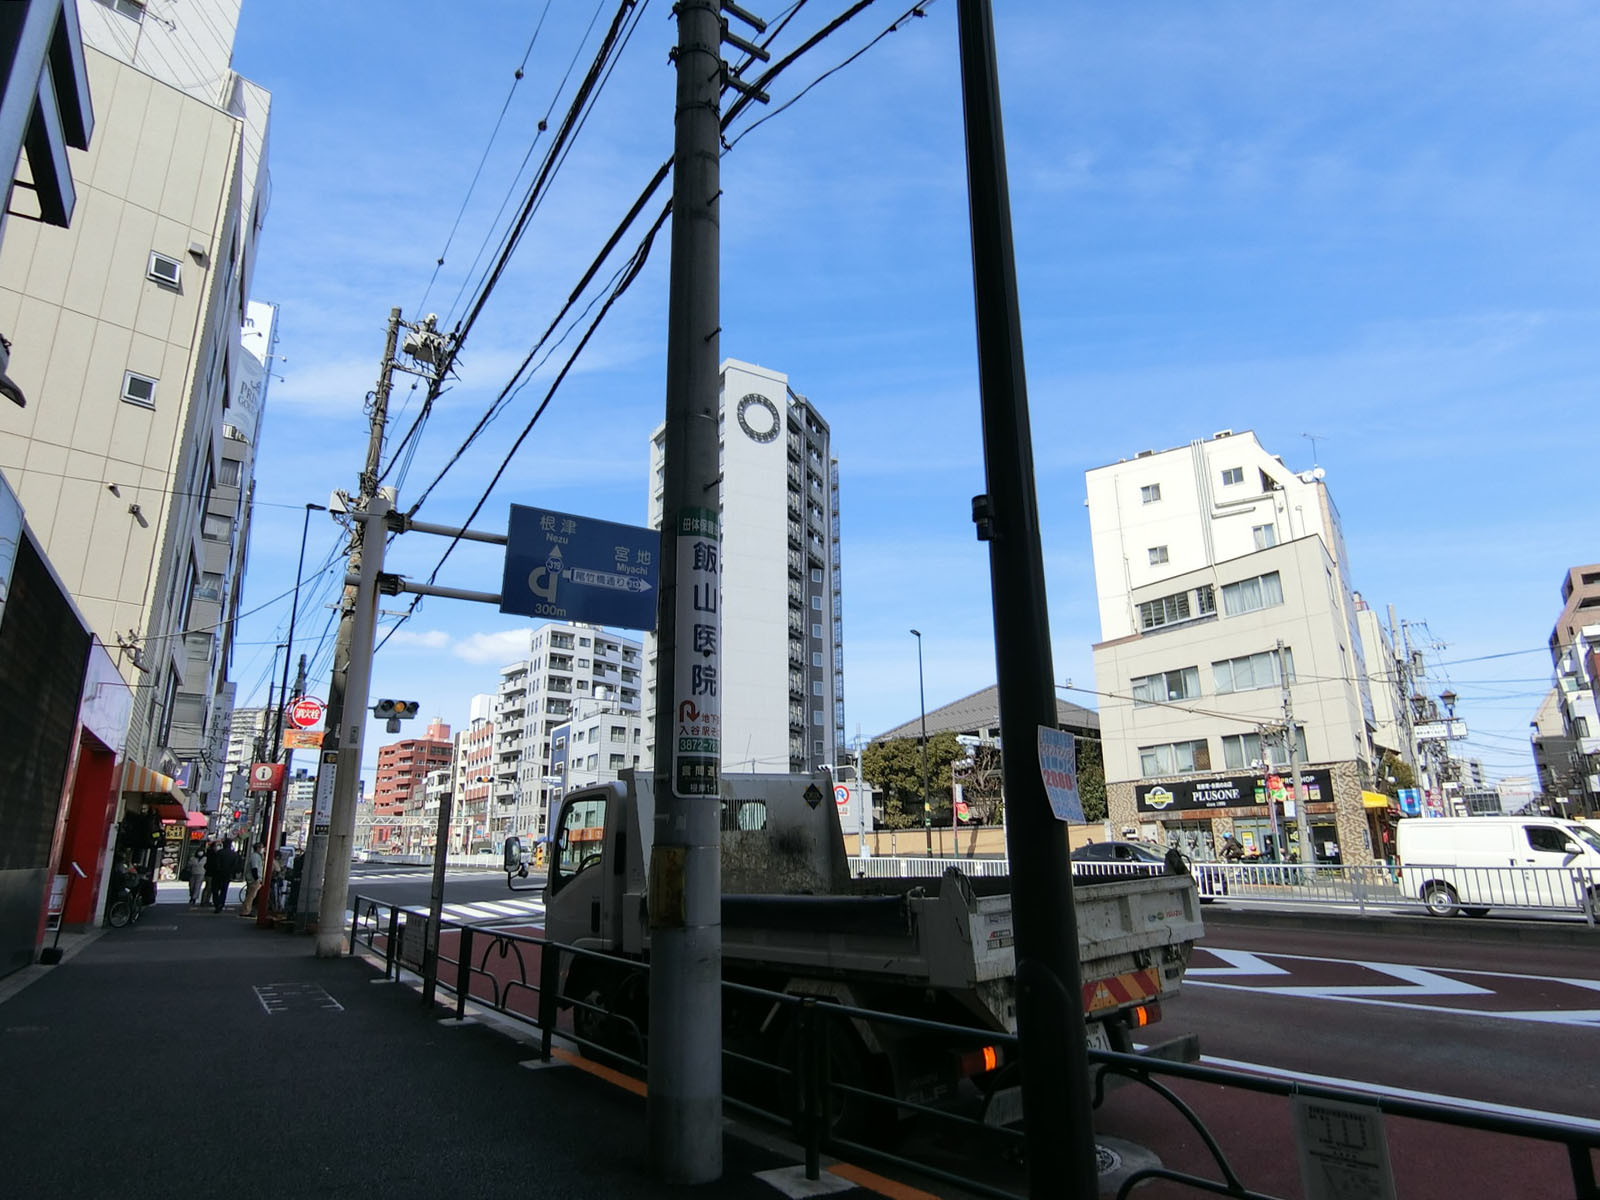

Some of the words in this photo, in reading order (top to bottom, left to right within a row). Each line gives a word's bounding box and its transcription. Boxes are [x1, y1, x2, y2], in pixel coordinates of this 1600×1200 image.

[539, 514, 577, 535] 根津
[545, 533, 569, 545] Nezu
[614, 546, 652, 566] 宮地
[548, 560, 561, 571] 319
[616, 562, 648, 577] Miyachi
[575, 571, 626, 587] 尾竹橋通り
[534, 602, 567, 617] 300m
[693, 541, 718, 698] 飯山医院
[296, 707, 320, 719] 消火栓
[1191, 788, 1241, 802] PLUSONE
